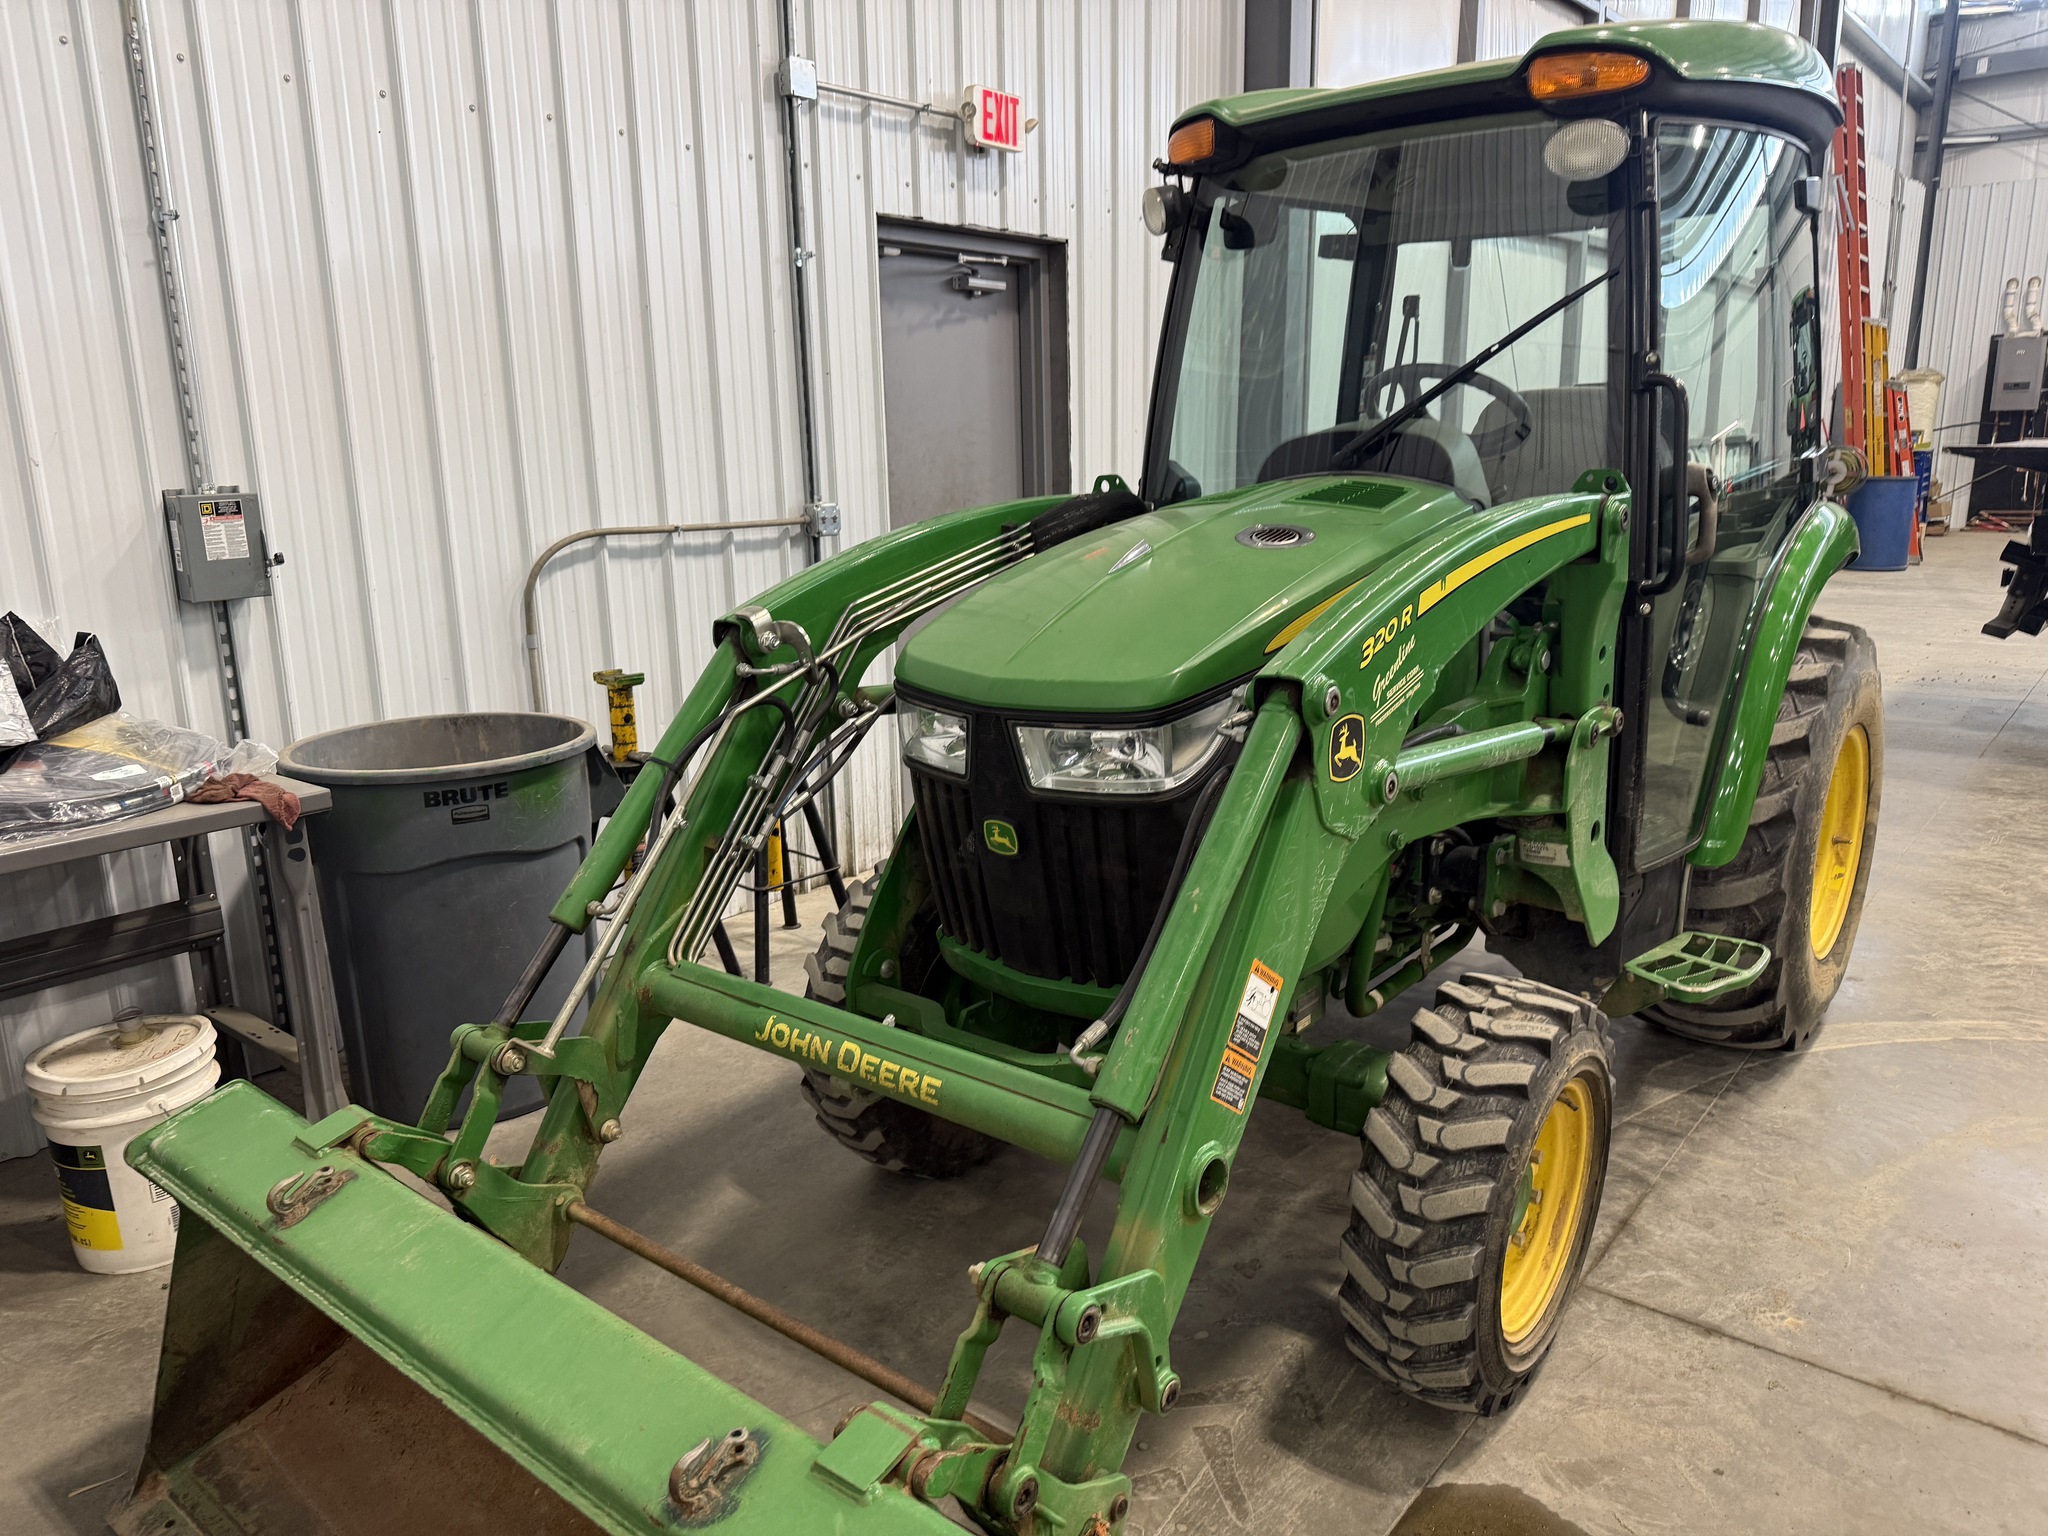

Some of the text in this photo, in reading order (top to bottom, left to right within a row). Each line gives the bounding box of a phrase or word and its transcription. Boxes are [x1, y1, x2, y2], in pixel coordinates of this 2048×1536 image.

[982, 89, 1019, 147] EXIT
[1359, 603, 1414, 670] 320 R
[1372, 634, 1416, 708] Greenline
[423, 781, 509, 808] BRUTE
[755, 1014, 943, 1106] JOHN DEERE
